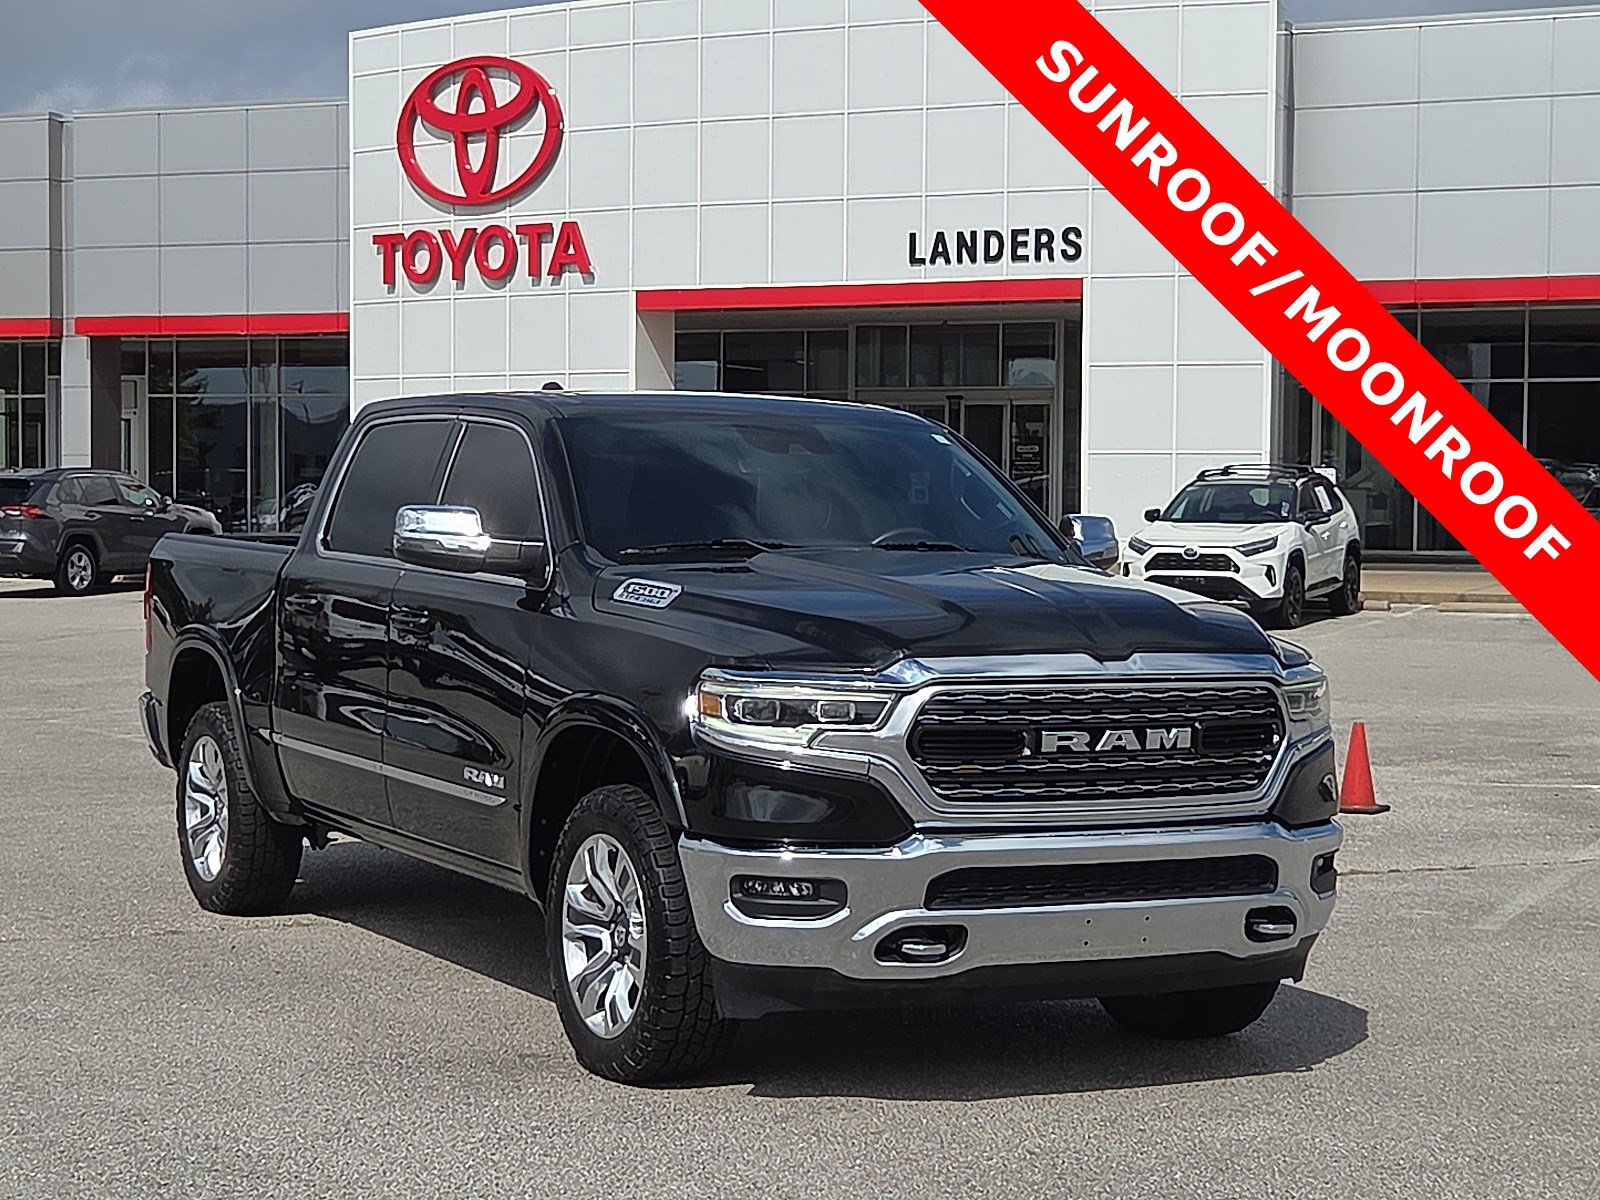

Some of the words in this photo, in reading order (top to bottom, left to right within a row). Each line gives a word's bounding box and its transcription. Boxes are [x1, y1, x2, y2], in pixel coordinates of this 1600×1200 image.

[373, 221, 591, 285] TOYOTA
[909, 226, 1083, 266] LANDERS
[626, 583, 672, 599] 1500
[1041, 727, 1192, 752] RAM
[463, 766, 506, 789] RAM
